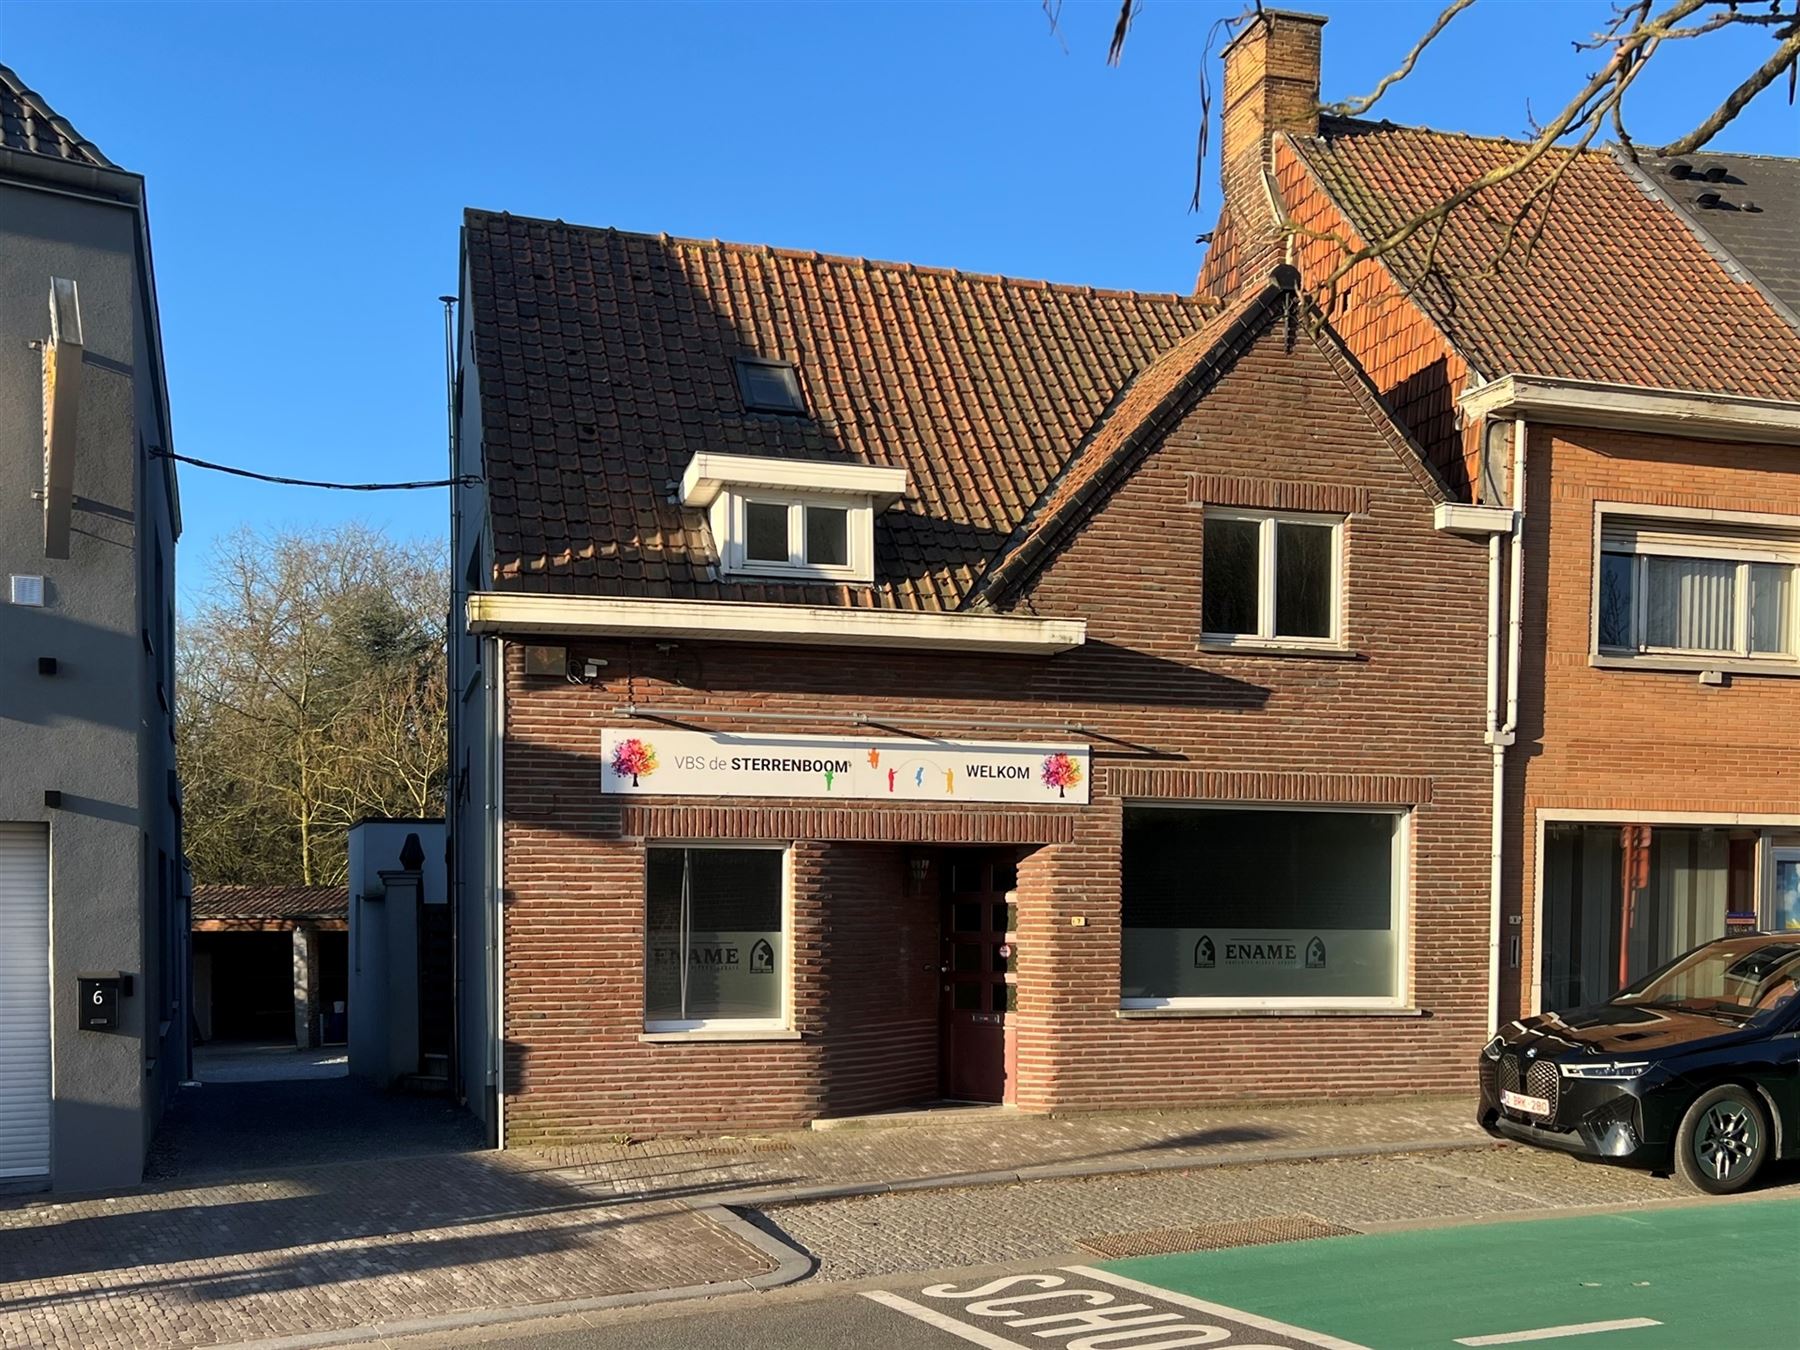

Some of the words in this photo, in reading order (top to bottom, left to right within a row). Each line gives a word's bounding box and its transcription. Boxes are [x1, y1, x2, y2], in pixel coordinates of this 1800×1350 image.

[675, 755, 705, 770] VBS
[709, 756, 727, 771] de
[731, 757, 849, 773] STERRENBOOM
[966, 764, 1030, 779] WELKOM
[1225, 944, 1297, 960] ENAME
[93, 990, 103, 1005] 6
[921, 1274, 1296, 1350] SCHO
